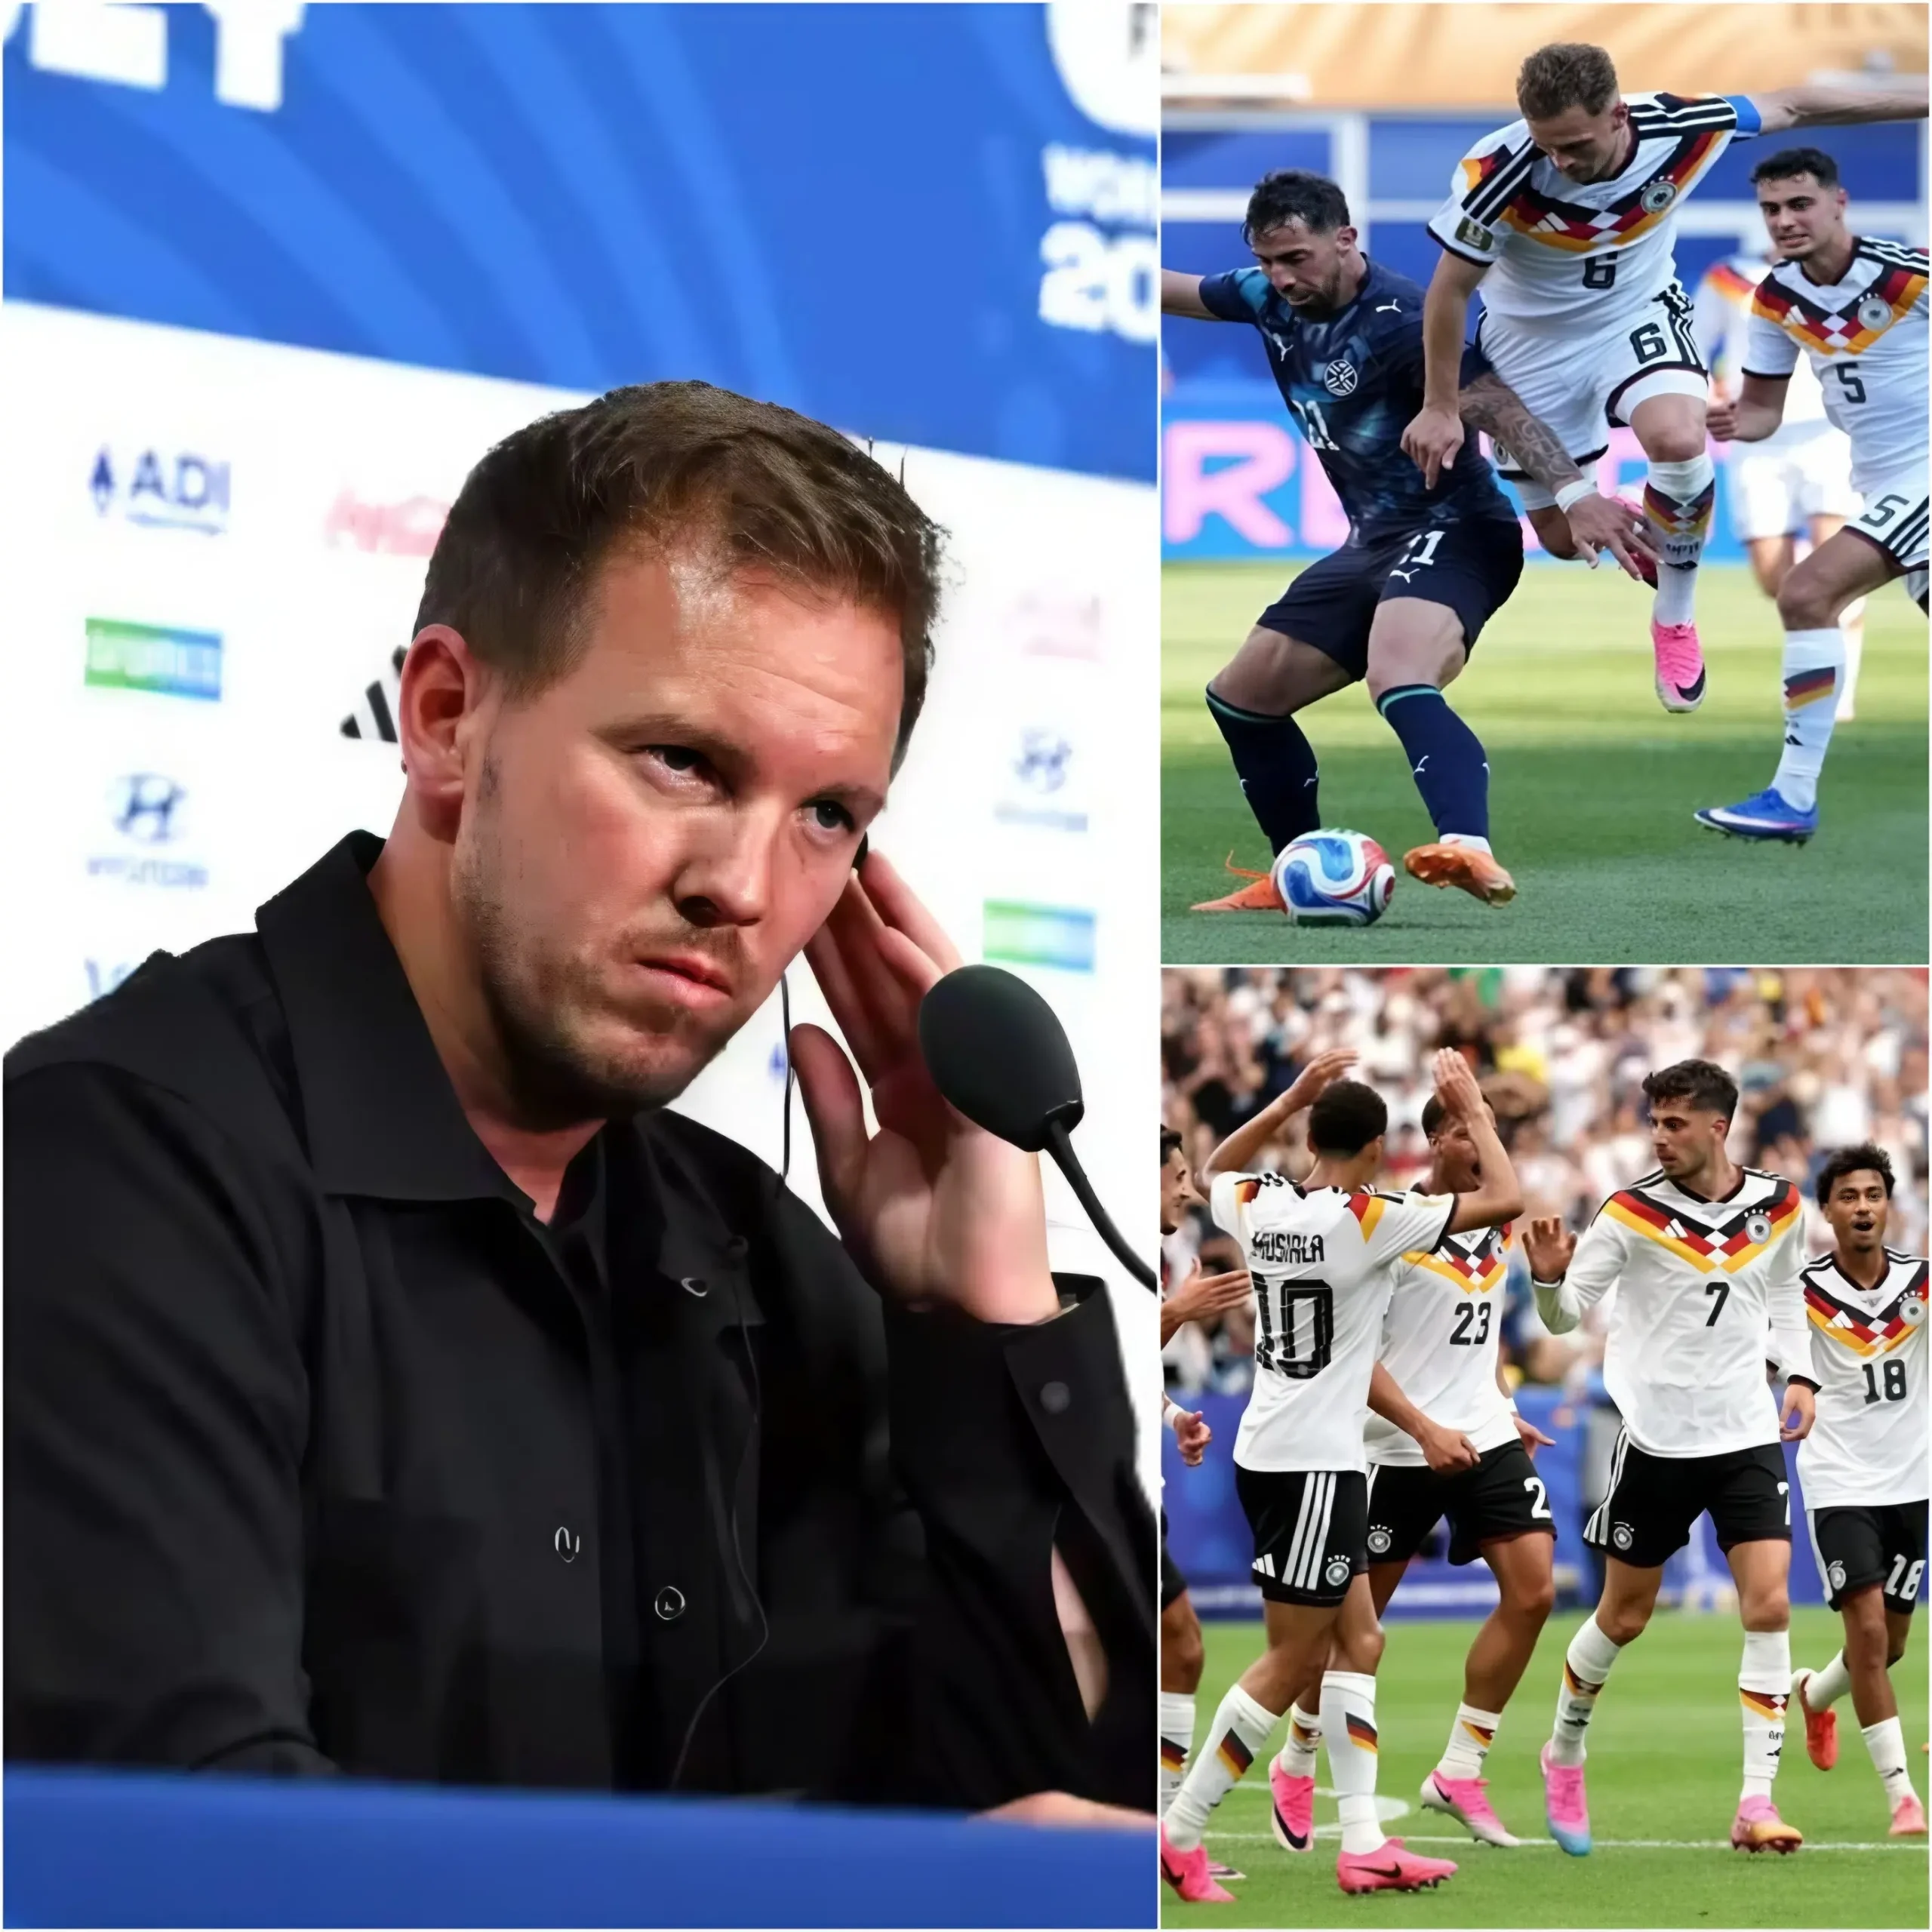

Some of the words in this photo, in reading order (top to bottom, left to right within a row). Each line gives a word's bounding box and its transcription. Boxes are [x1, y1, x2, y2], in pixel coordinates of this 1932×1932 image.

[1582, 251, 1618, 289] 6
[1629, 322, 1667, 365] 6
[1835, 361, 1866, 404] 5
[1859, 494, 1910, 528] 5
[1251, 1270, 1334, 1379] 10
[1450, 1302, 1491, 1345] 23
[1706, 1281, 1730, 1327] 7
[1862, 1359, 1906, 1404] 18
[1524, 1476, 1552, 1518] 2
[1884, 1553, 1927, 1600] 18
